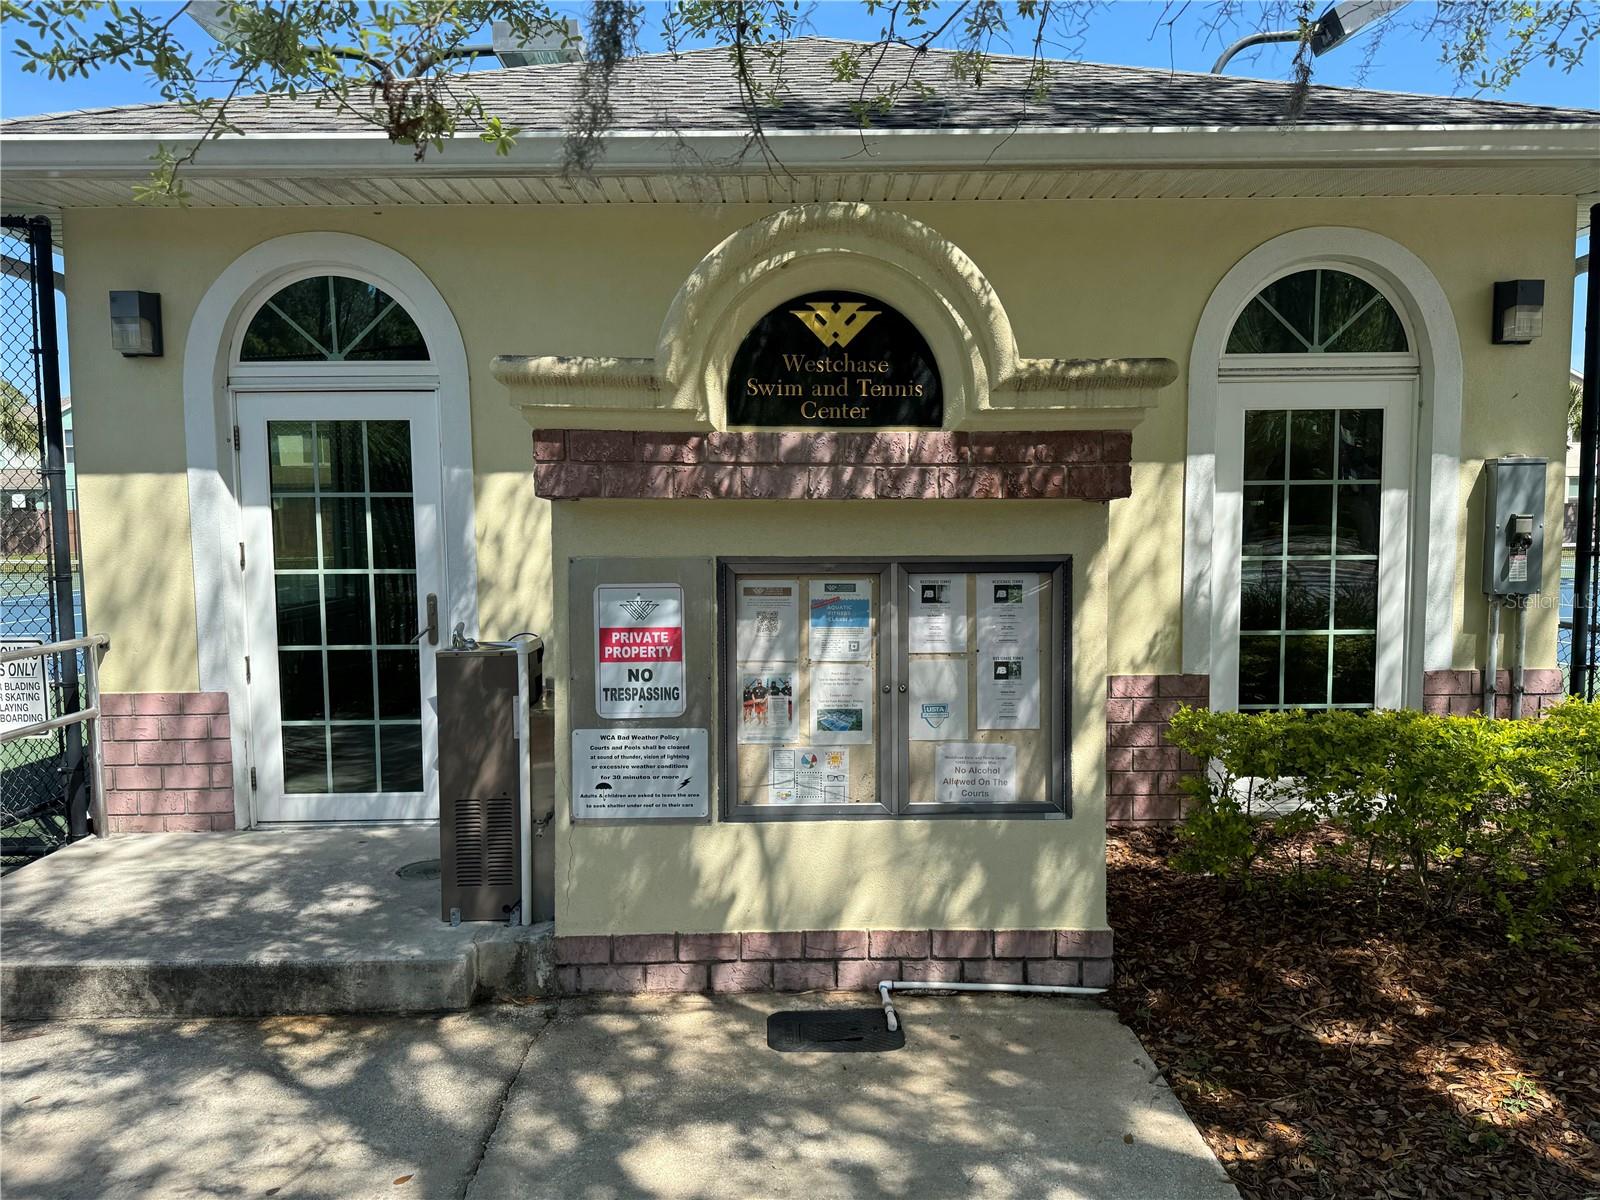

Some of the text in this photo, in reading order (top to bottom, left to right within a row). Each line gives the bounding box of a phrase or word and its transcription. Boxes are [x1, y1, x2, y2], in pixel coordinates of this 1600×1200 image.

[782, 353, 889, 373] Westchase
[747, 378, 923, 397] Swim and Tennis
[800, 401, 870, 419] Center
[612, 632, 668, 643] PRIVATE
[605, 646, 673, 658] PROPERTY
[9, 663, 37, 676] ONLY
[627, 669, 653, 682] NO
[5, 693, 40, 701] SKATING
[603, 687, 679, 702] TRESPASSING
